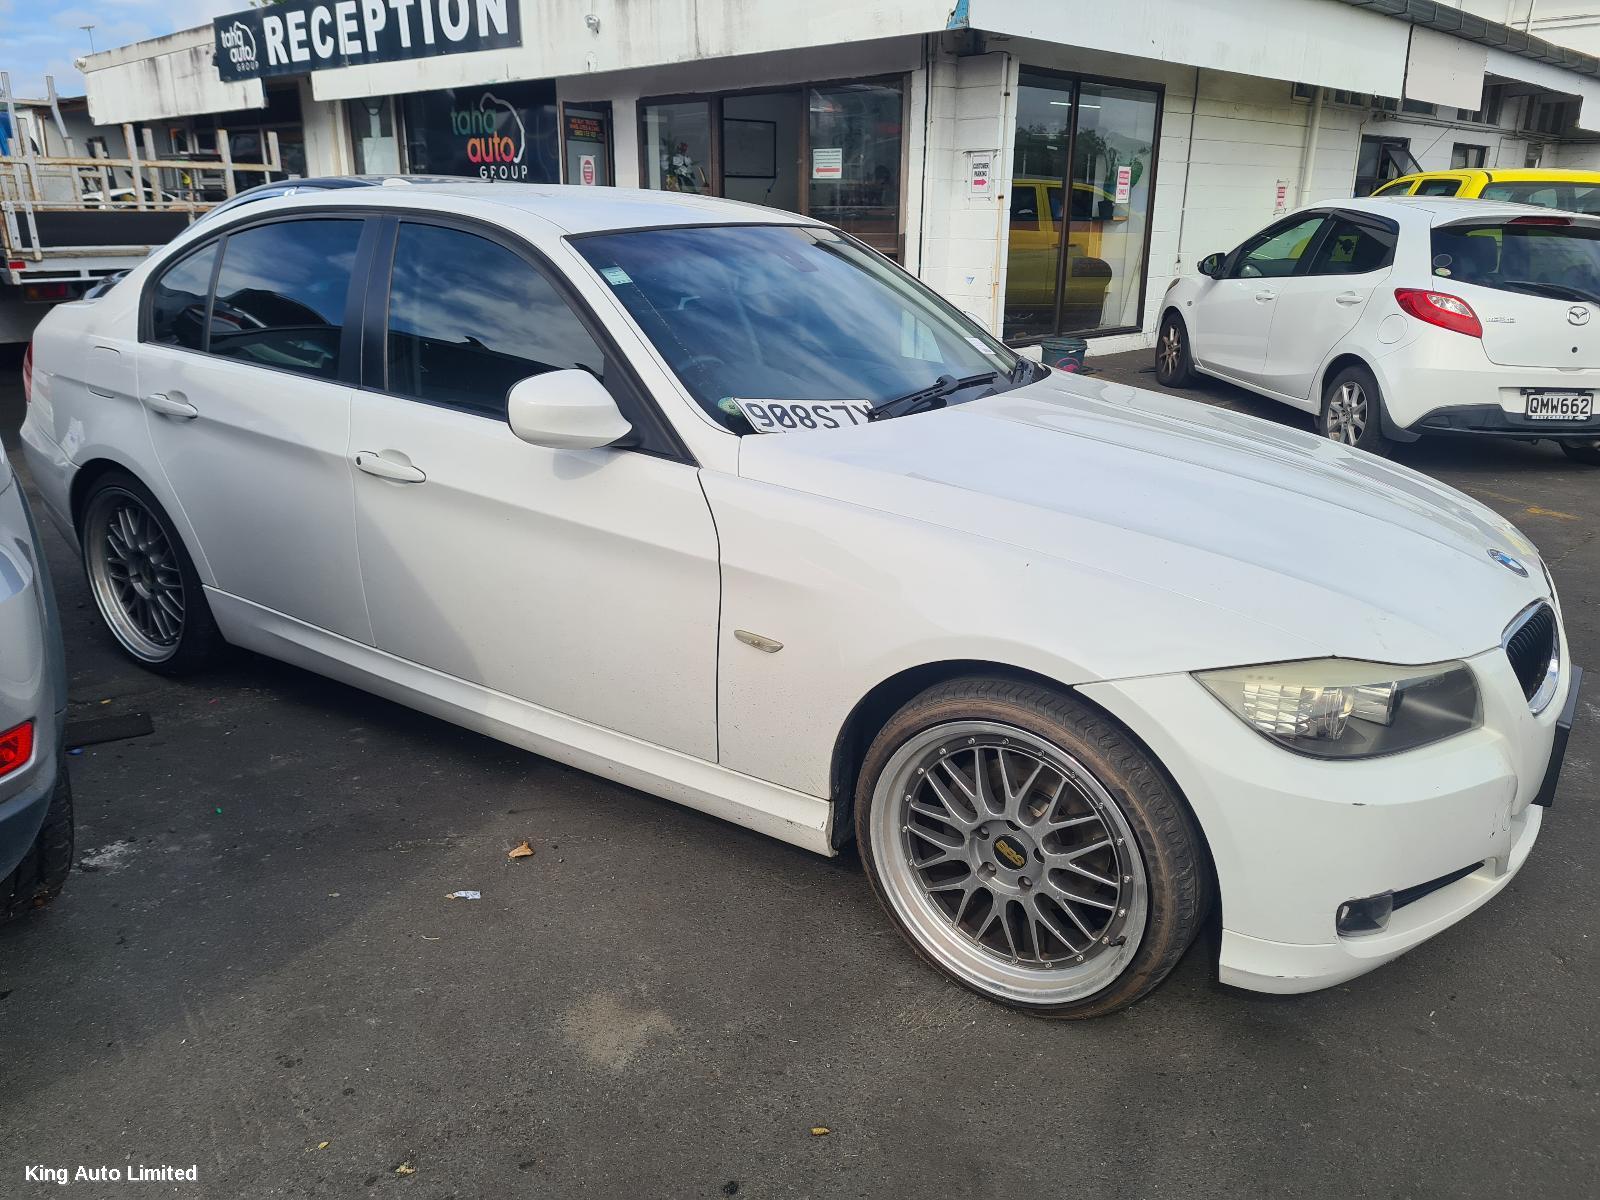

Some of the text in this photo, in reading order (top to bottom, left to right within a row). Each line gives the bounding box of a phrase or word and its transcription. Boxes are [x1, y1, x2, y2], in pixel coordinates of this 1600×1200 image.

[263, 0, 509, 65] RECEPTION
[230, 45, 253, 63] auto
[236, 60, 259, 71] GROUP
[450, 101, 497, 135] taha
[467, 131, 515, 163] auto
[479, 165, 528, 180] GROUP
[1529, 397, 1590, 415] QMW662
